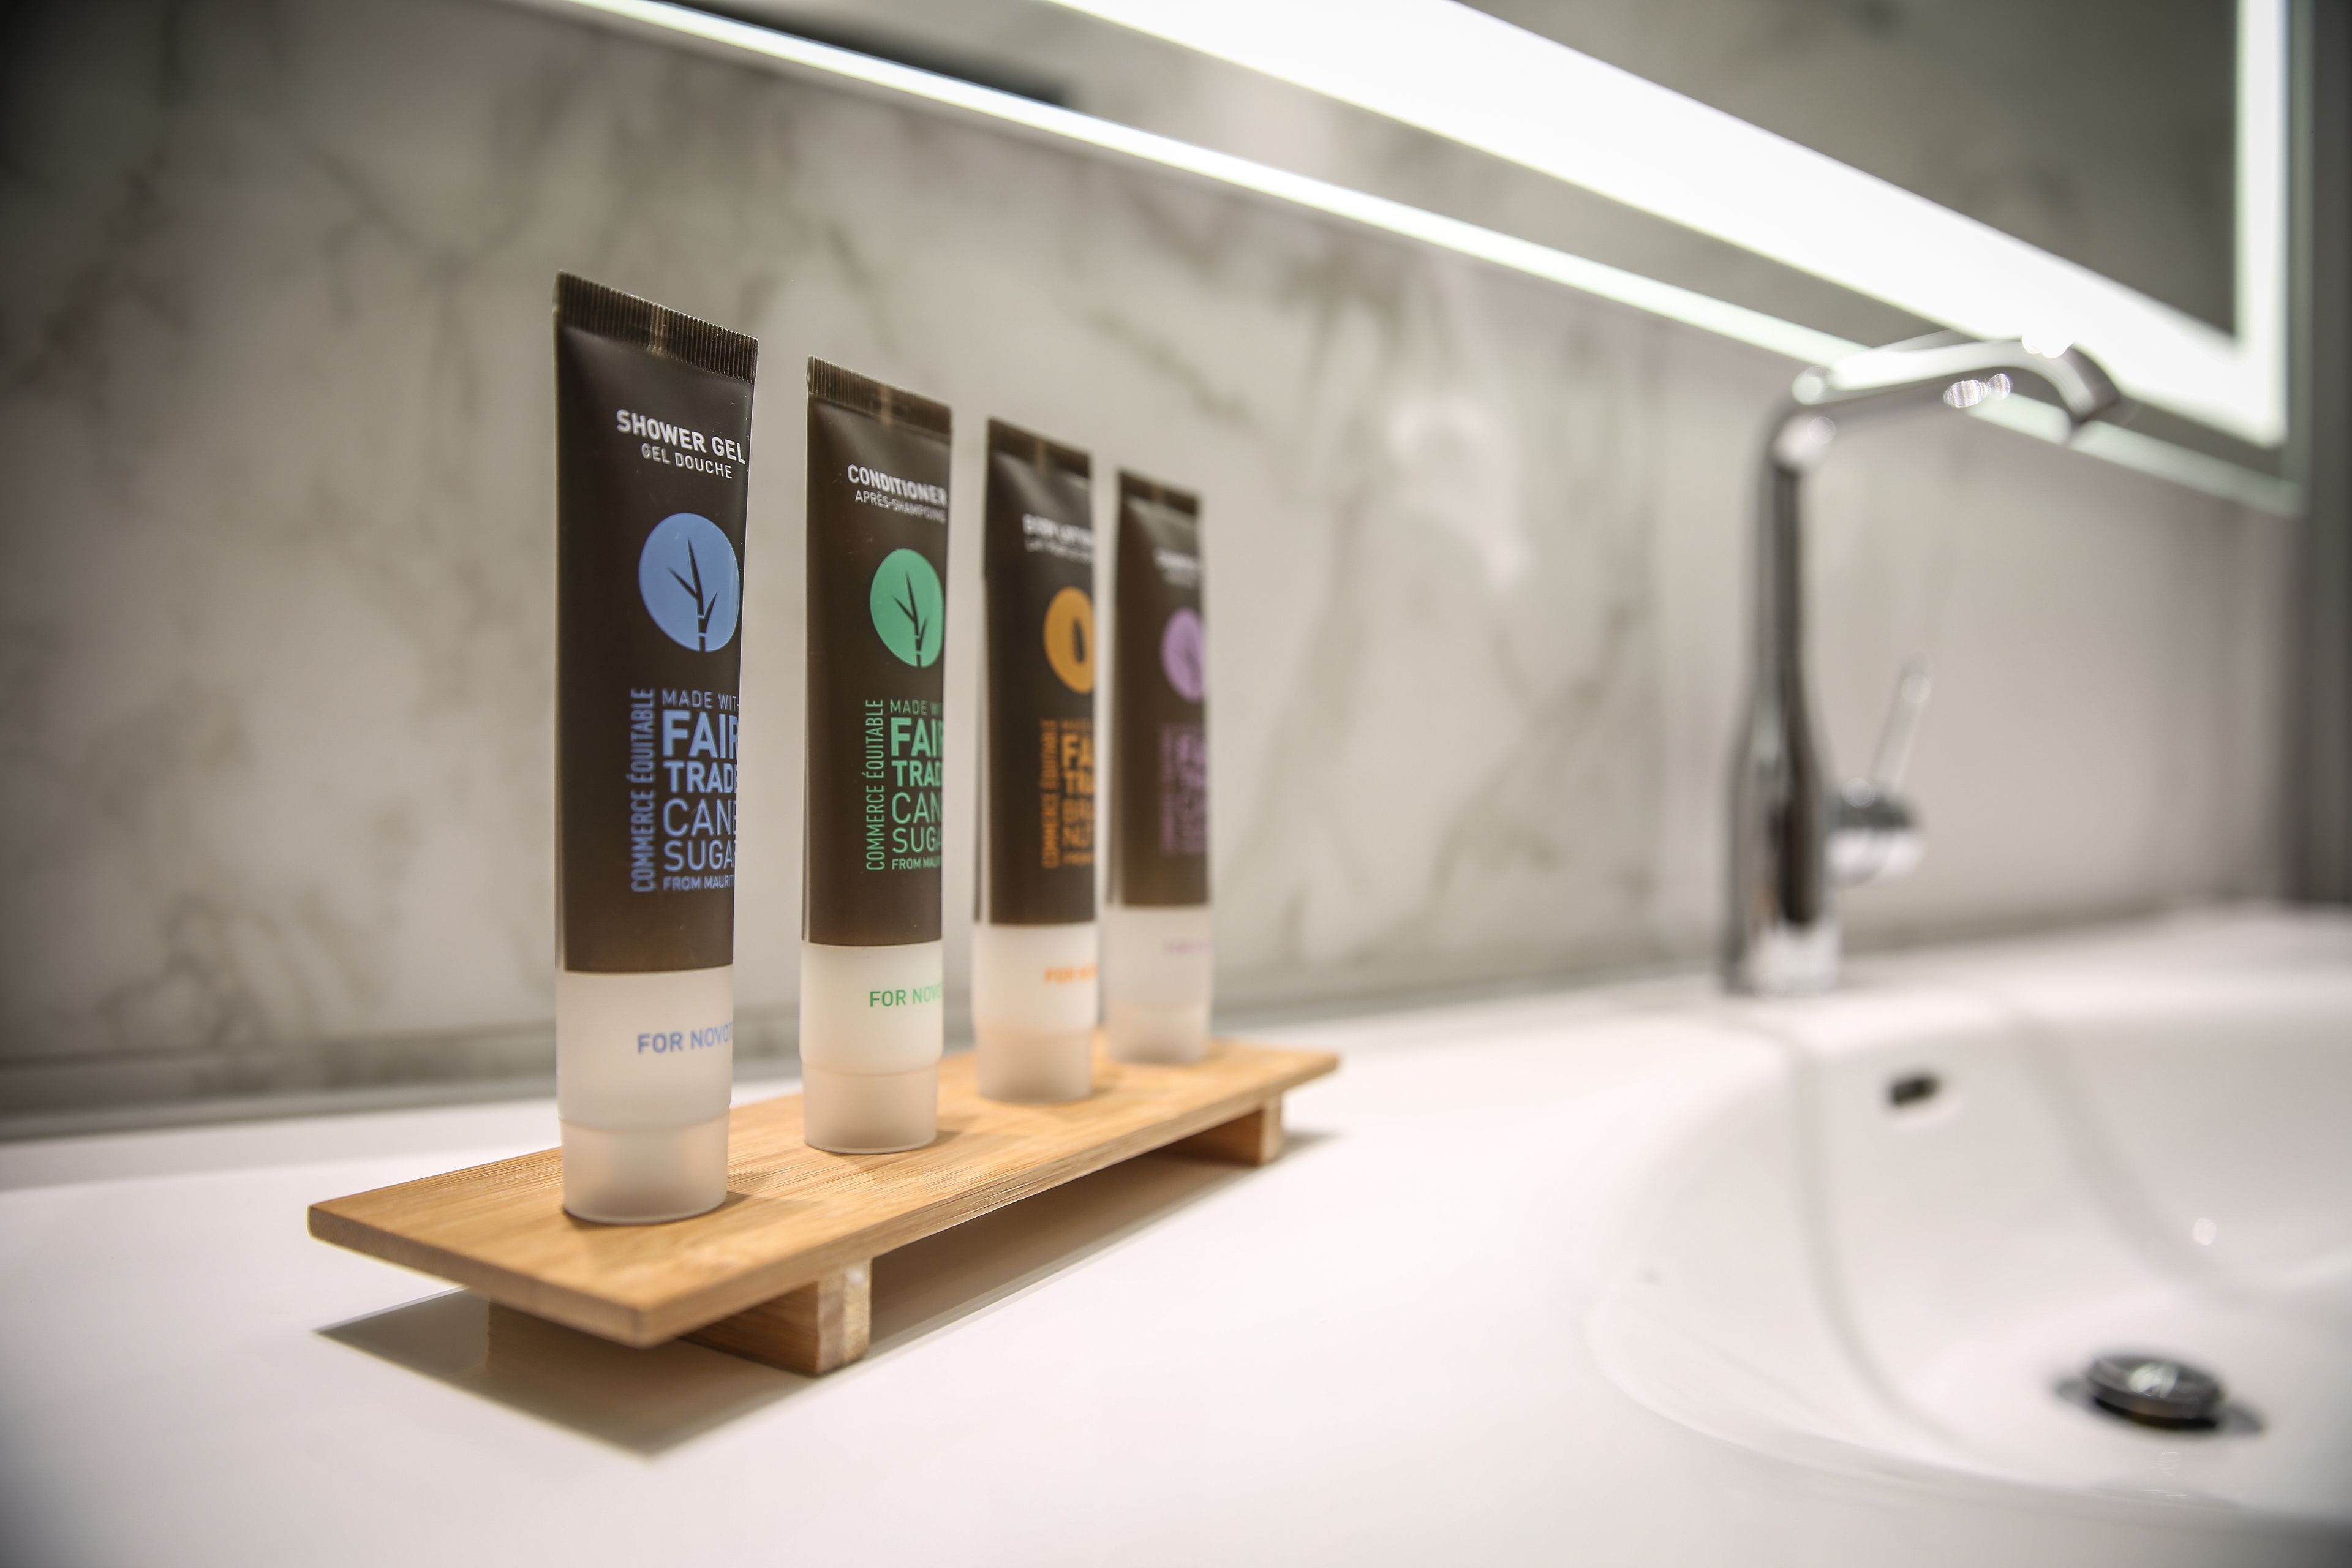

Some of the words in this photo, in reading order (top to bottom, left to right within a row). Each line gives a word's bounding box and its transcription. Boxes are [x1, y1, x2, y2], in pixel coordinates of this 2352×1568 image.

[616, 409, 706, 453] SHOWER
[711, 436, 746, 464] GEL
[641, 443, 671, 465] GEL
[675, 452, 733, 479] DOUCHE
[848, 464, 948, 508] CONDITIONER
[662, 689, 713, 709] MADE
[890, 699, 927, 716] MADE
[626, 688, 655, 783] ÉQUITABLE
[862, 699, 884, 778] ÉQUITABLE
[631, 789, 655, 892] COMMERCE
[866, 785, 885, 870] COMMERCE
[892, 858, 921, 870] FROM
[663, 876, 701, 891] FROM
[870, 990, 907, 1008] FOR
[638, 1031, 684, 1054] FOR
